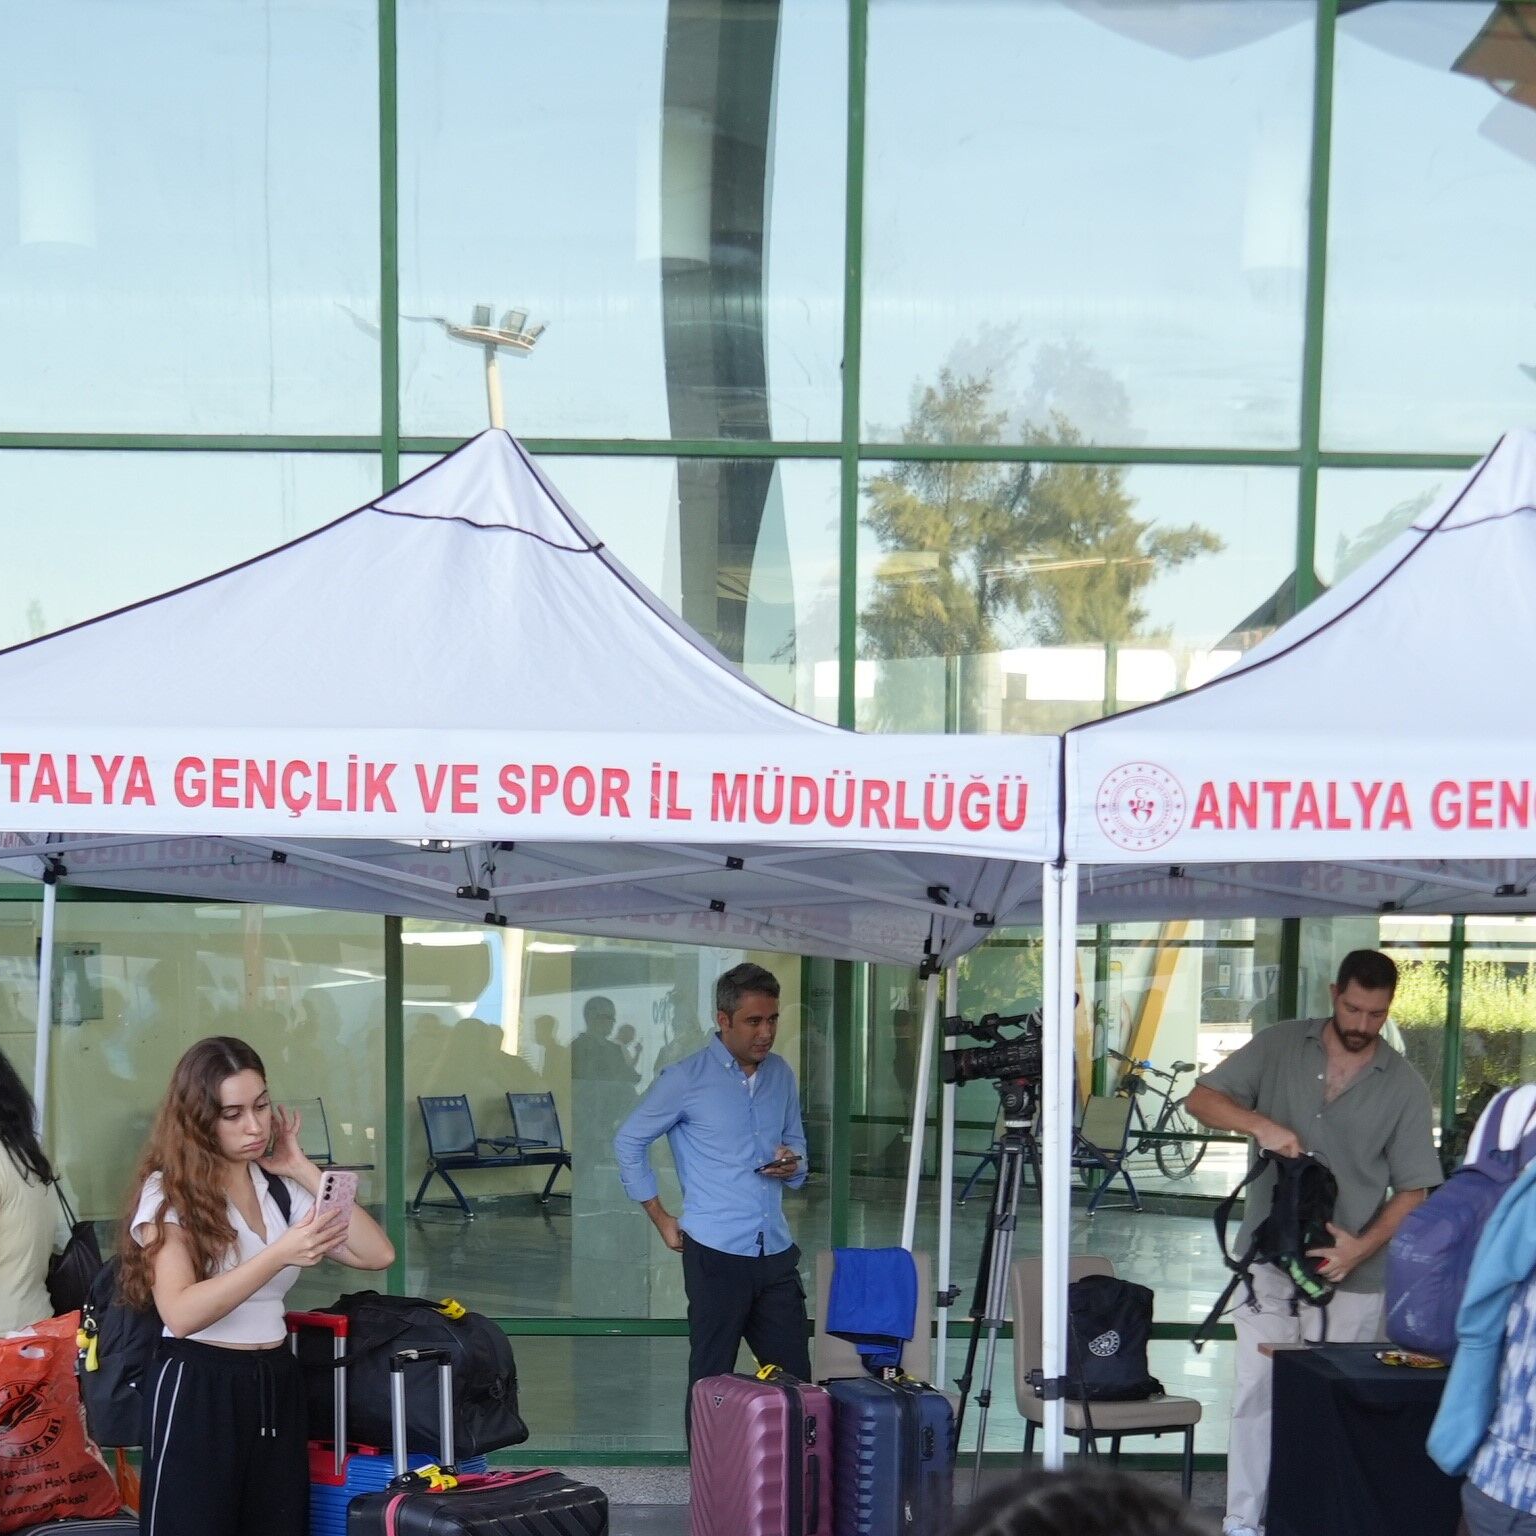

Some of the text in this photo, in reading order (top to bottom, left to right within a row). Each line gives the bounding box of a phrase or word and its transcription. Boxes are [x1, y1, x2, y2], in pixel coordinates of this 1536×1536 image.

[174, 754, 398, 818] GENÇLİK
[415, 763, 478, 814] VE
[497, 763, 631, 818] SPOR
[650, 762, 692, 821] İL
[710, 766, 1028, 832] MÜDÜRLÜĞÜ
[1190, 780, 1412, 831] ANTALYA
